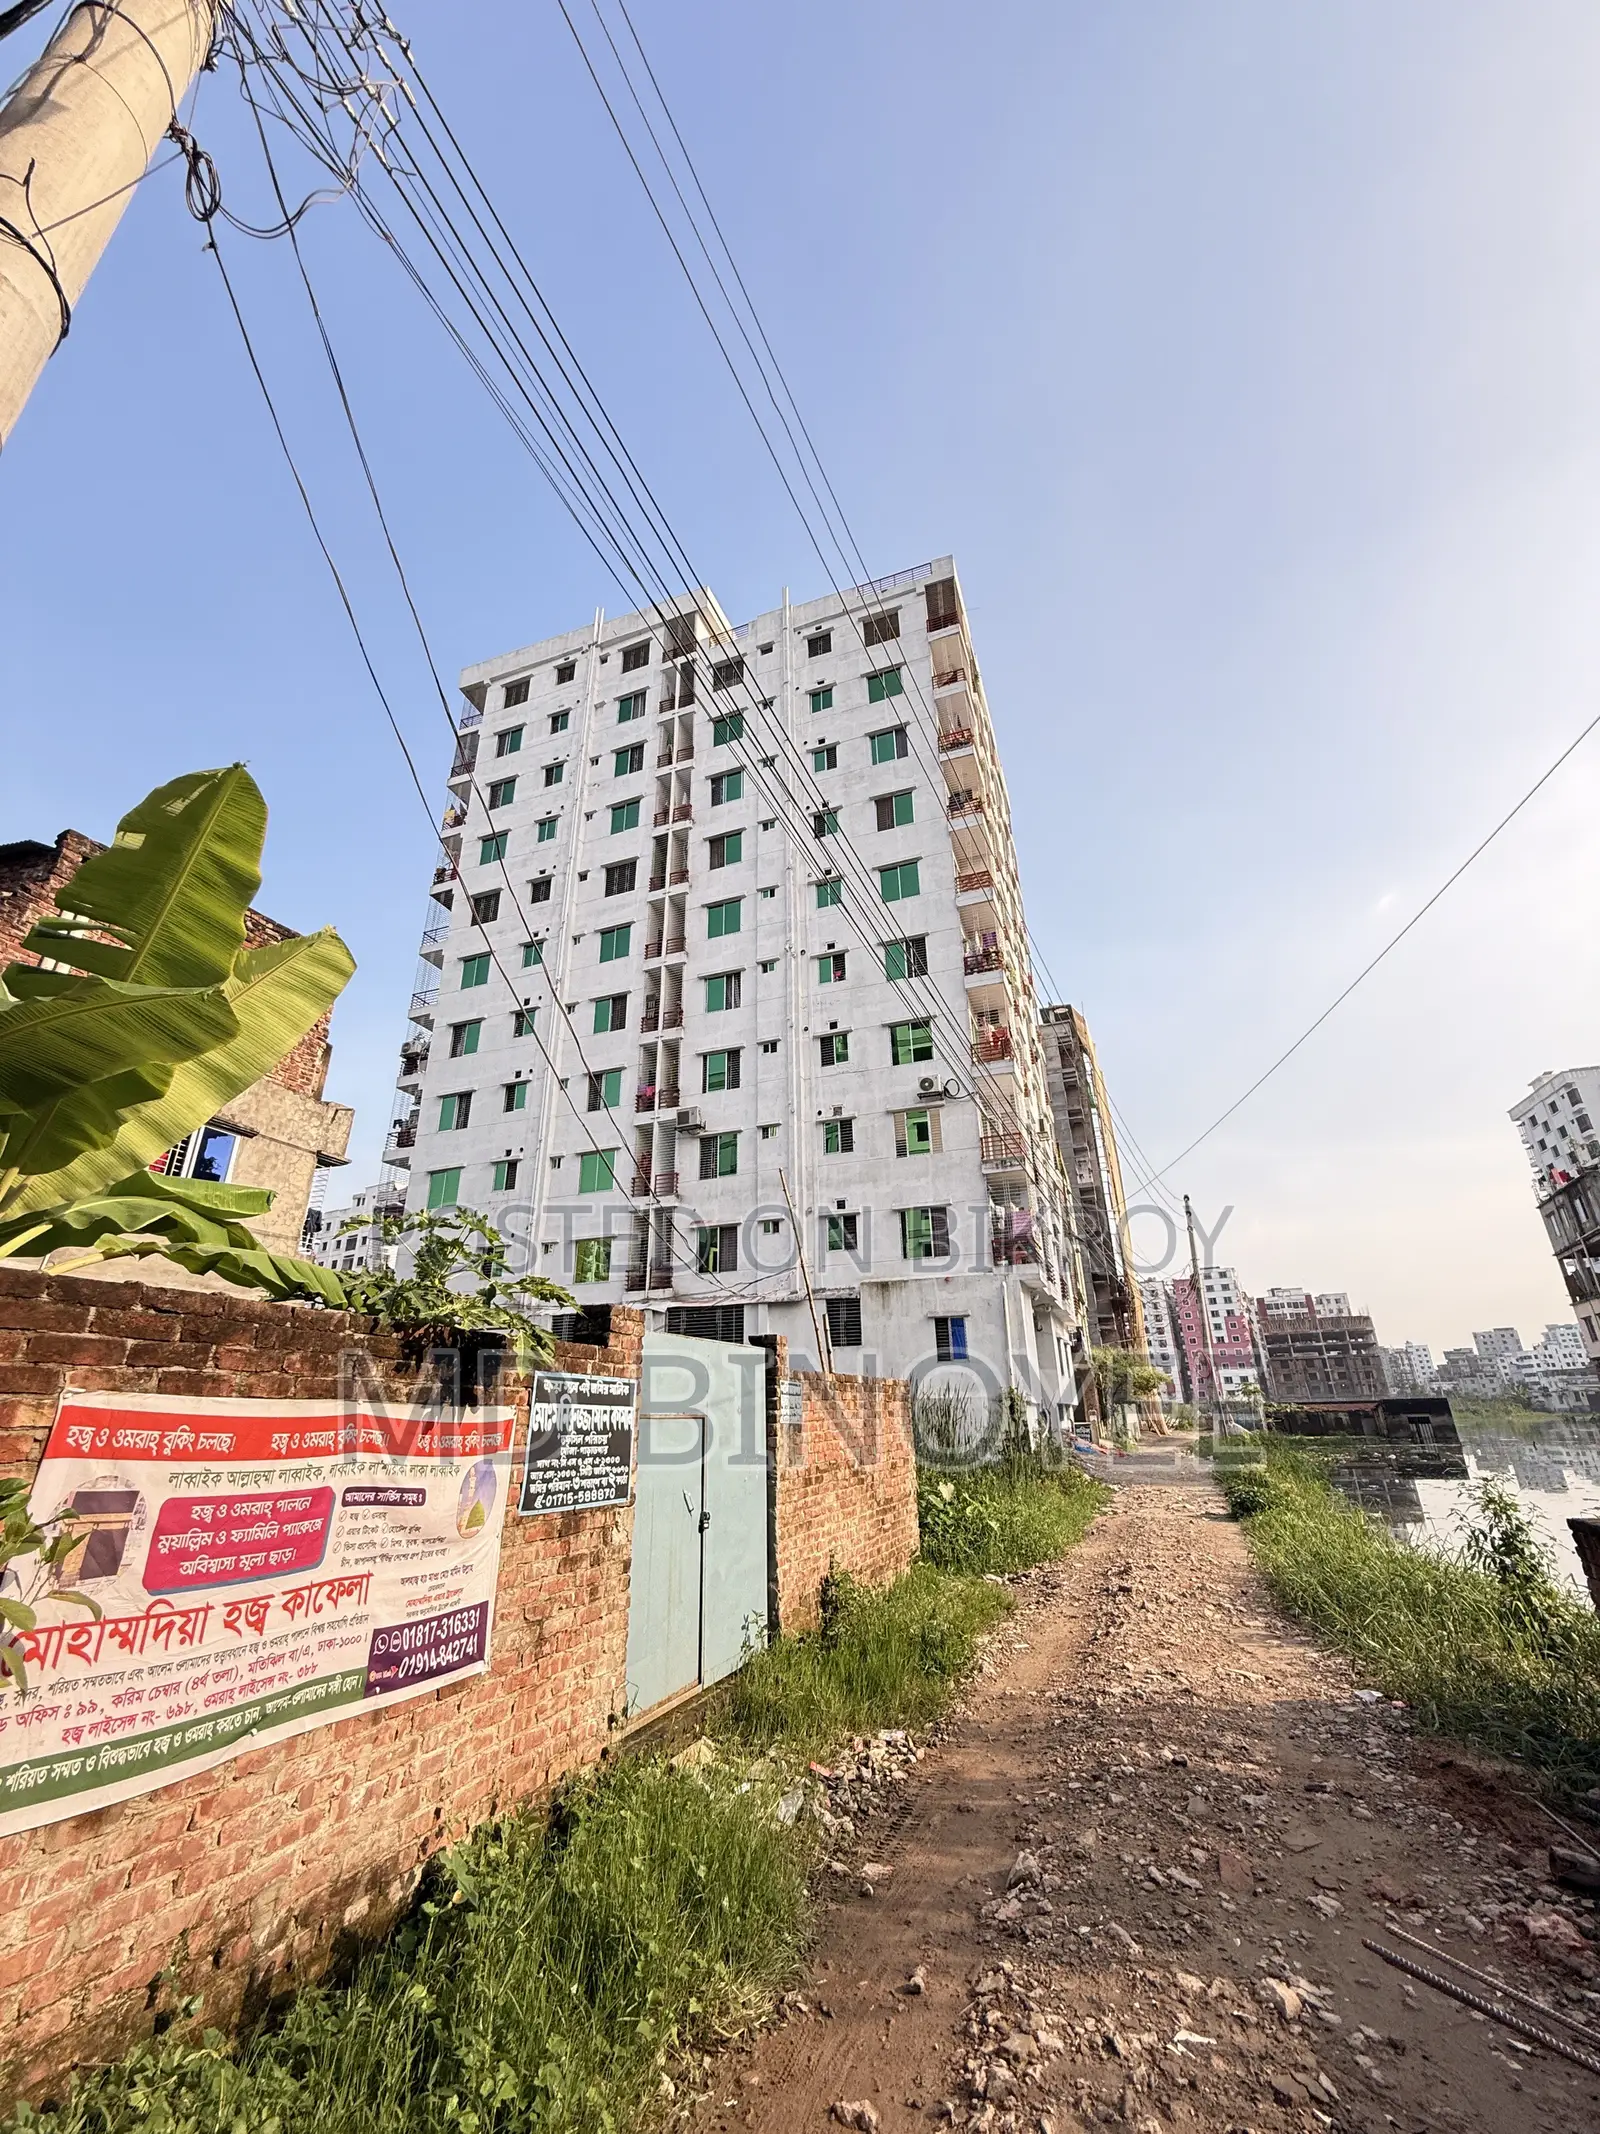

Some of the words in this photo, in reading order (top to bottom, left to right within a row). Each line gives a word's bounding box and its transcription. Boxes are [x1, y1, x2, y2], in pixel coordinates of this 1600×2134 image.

[590, 1380, 609, 1395] জমির
[609, 1381, 630, 1396] মালিক
[96, 1428, 110, 1448] ও
[162, 1425, 194, 1456] বুকিং
[290, 1434, 299, 1449] ও
[337, 1423, 359, 1450] বুকিং
[432, 1435, 438, 1449] ও
[168, 1468, 224, 1489] লাব্বাইক
[227, 1469, 276, 1489] আল্লাহুম্মা
[278, 1462, 327, 1483] লাব্বাইক,
[216, 1504, 227, 1518] ও
[276, 1496, 313, 1513] পালনে
[344, 1491, 376, 1503] আমাদের
[157, 1528, 214, 1554] মুয়াল্লিম
[215, 1530, 227, 1545] ও
[230, 1521, 280, 1543] ফ্যামিলি
[282, 1518, 324, 1536] প্যাকেজে
[179, 1555, 236, 1575] অবিশ্বাস্য
[239, 1551, 267, 1571] মূল্য
[282, 1572, 374, 1621] কাফেলা
[403, 1607, 480, 1651] 01817-316331
[128, 1668, 144, 1681] এবং
[148, 1662, 174, 1676] আলেম
[261, 1640, 267, 1650] ও
[398, 1633, 478, 1678] 01914-842741
[16, 1704, 61, 1728] অফিস
[77, 1700, 104, 1716] ৯৯,
[112, 1687, 146, 1708] করিম
[148, 1681, 183, 1699] চেম্বার
[212, 1665, 244, 1687] তলা),
[248, 1650, 285, 1674] মতিঝিল
[88, 1712, 139, 1738] লাইসেন্স
[166, 1701, 198, 1720] ৬৯৮,
[238, 1672, 276, 1697] লাইসেন্স
[51, 1758, 84, 1781] সম্মত
[85, 1755, 96, 1772] ও
[98, 1741, 152, 1771] বিশুদ্ধভাবে
[174, 1732, 182, 1746] ও
[216, 1709, 244, 1731] করতে
